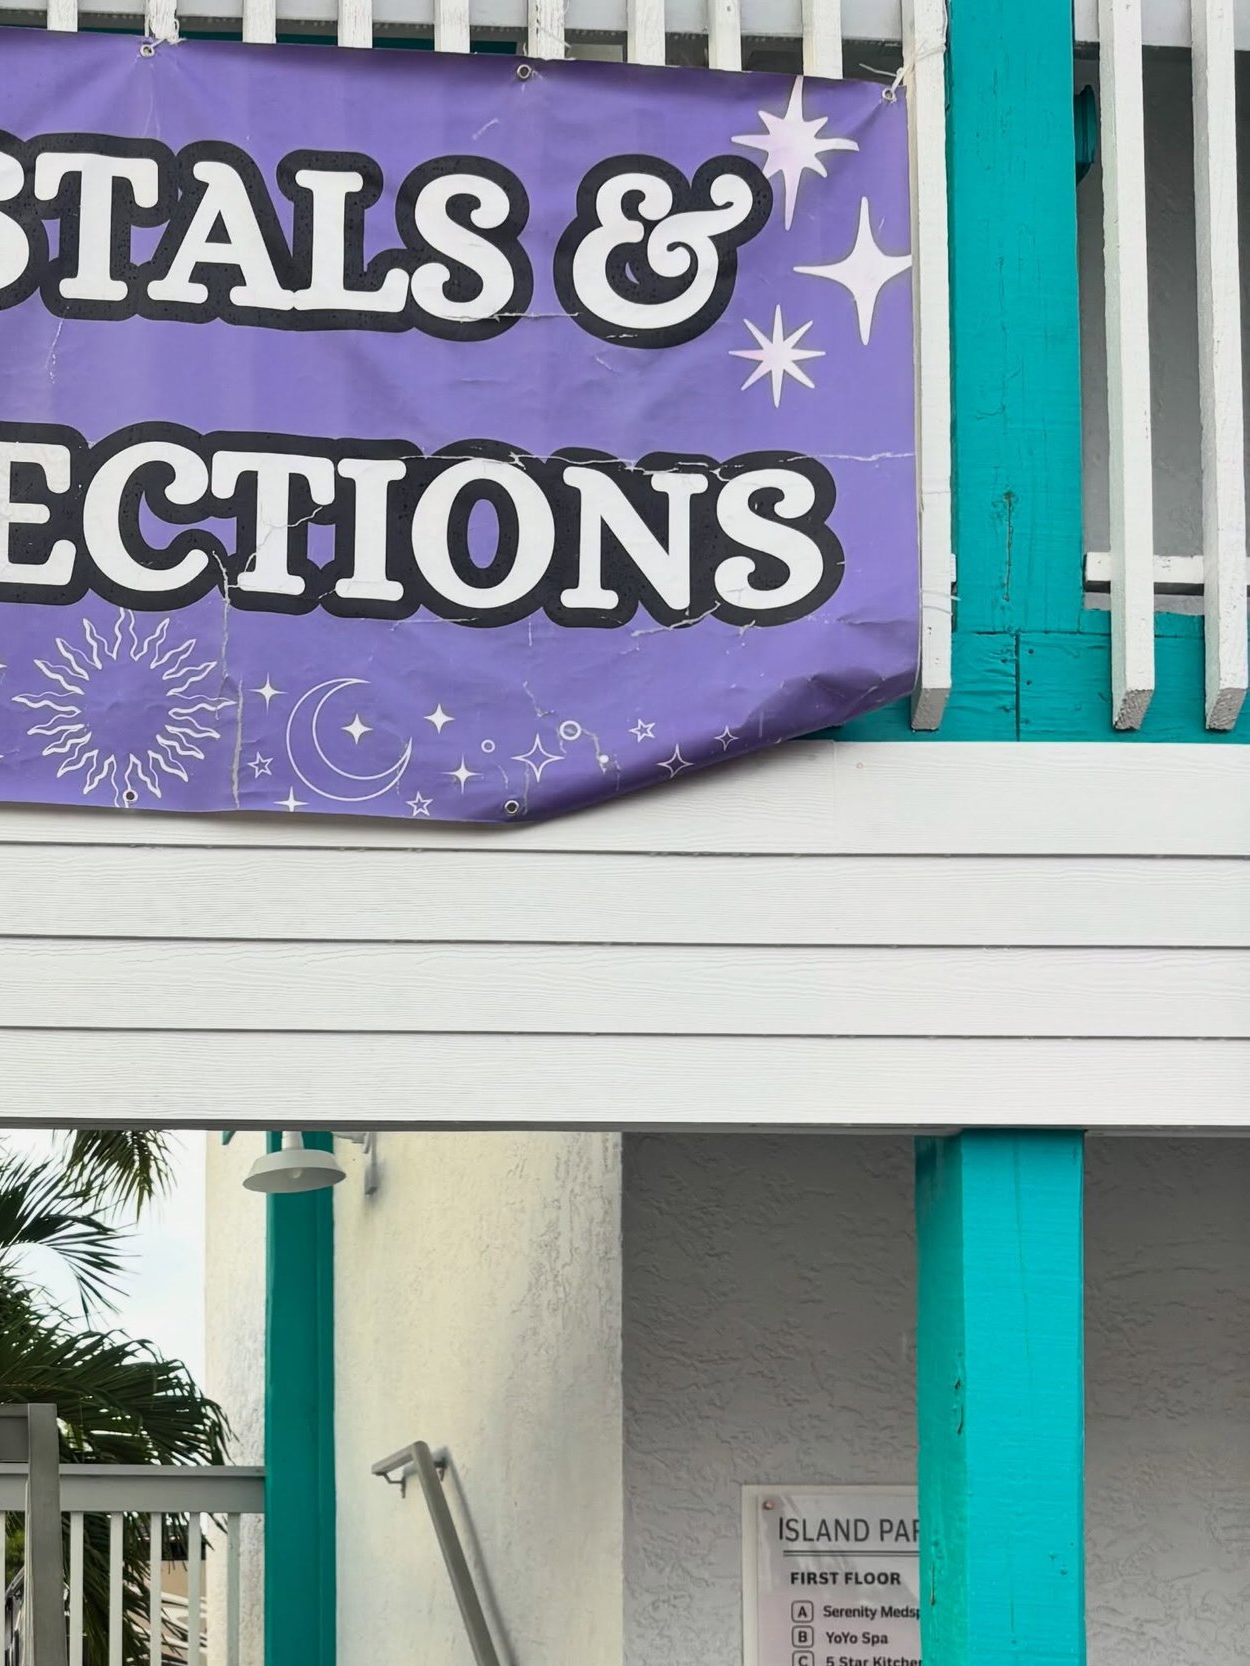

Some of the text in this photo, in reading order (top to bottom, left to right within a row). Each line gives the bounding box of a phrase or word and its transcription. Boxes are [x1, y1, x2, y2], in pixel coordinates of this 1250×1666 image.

[565, 155, 762, 342] &
[778, 1516, 870, 1543] ISLAND
[790, 1571, 901, 1586] FIRST FLOOR
[797, 1606, 808, 1619] A
[822, 1605, 878, 1621] Serenity
[798, 1630, 889, 1647] B YoYo Spa
